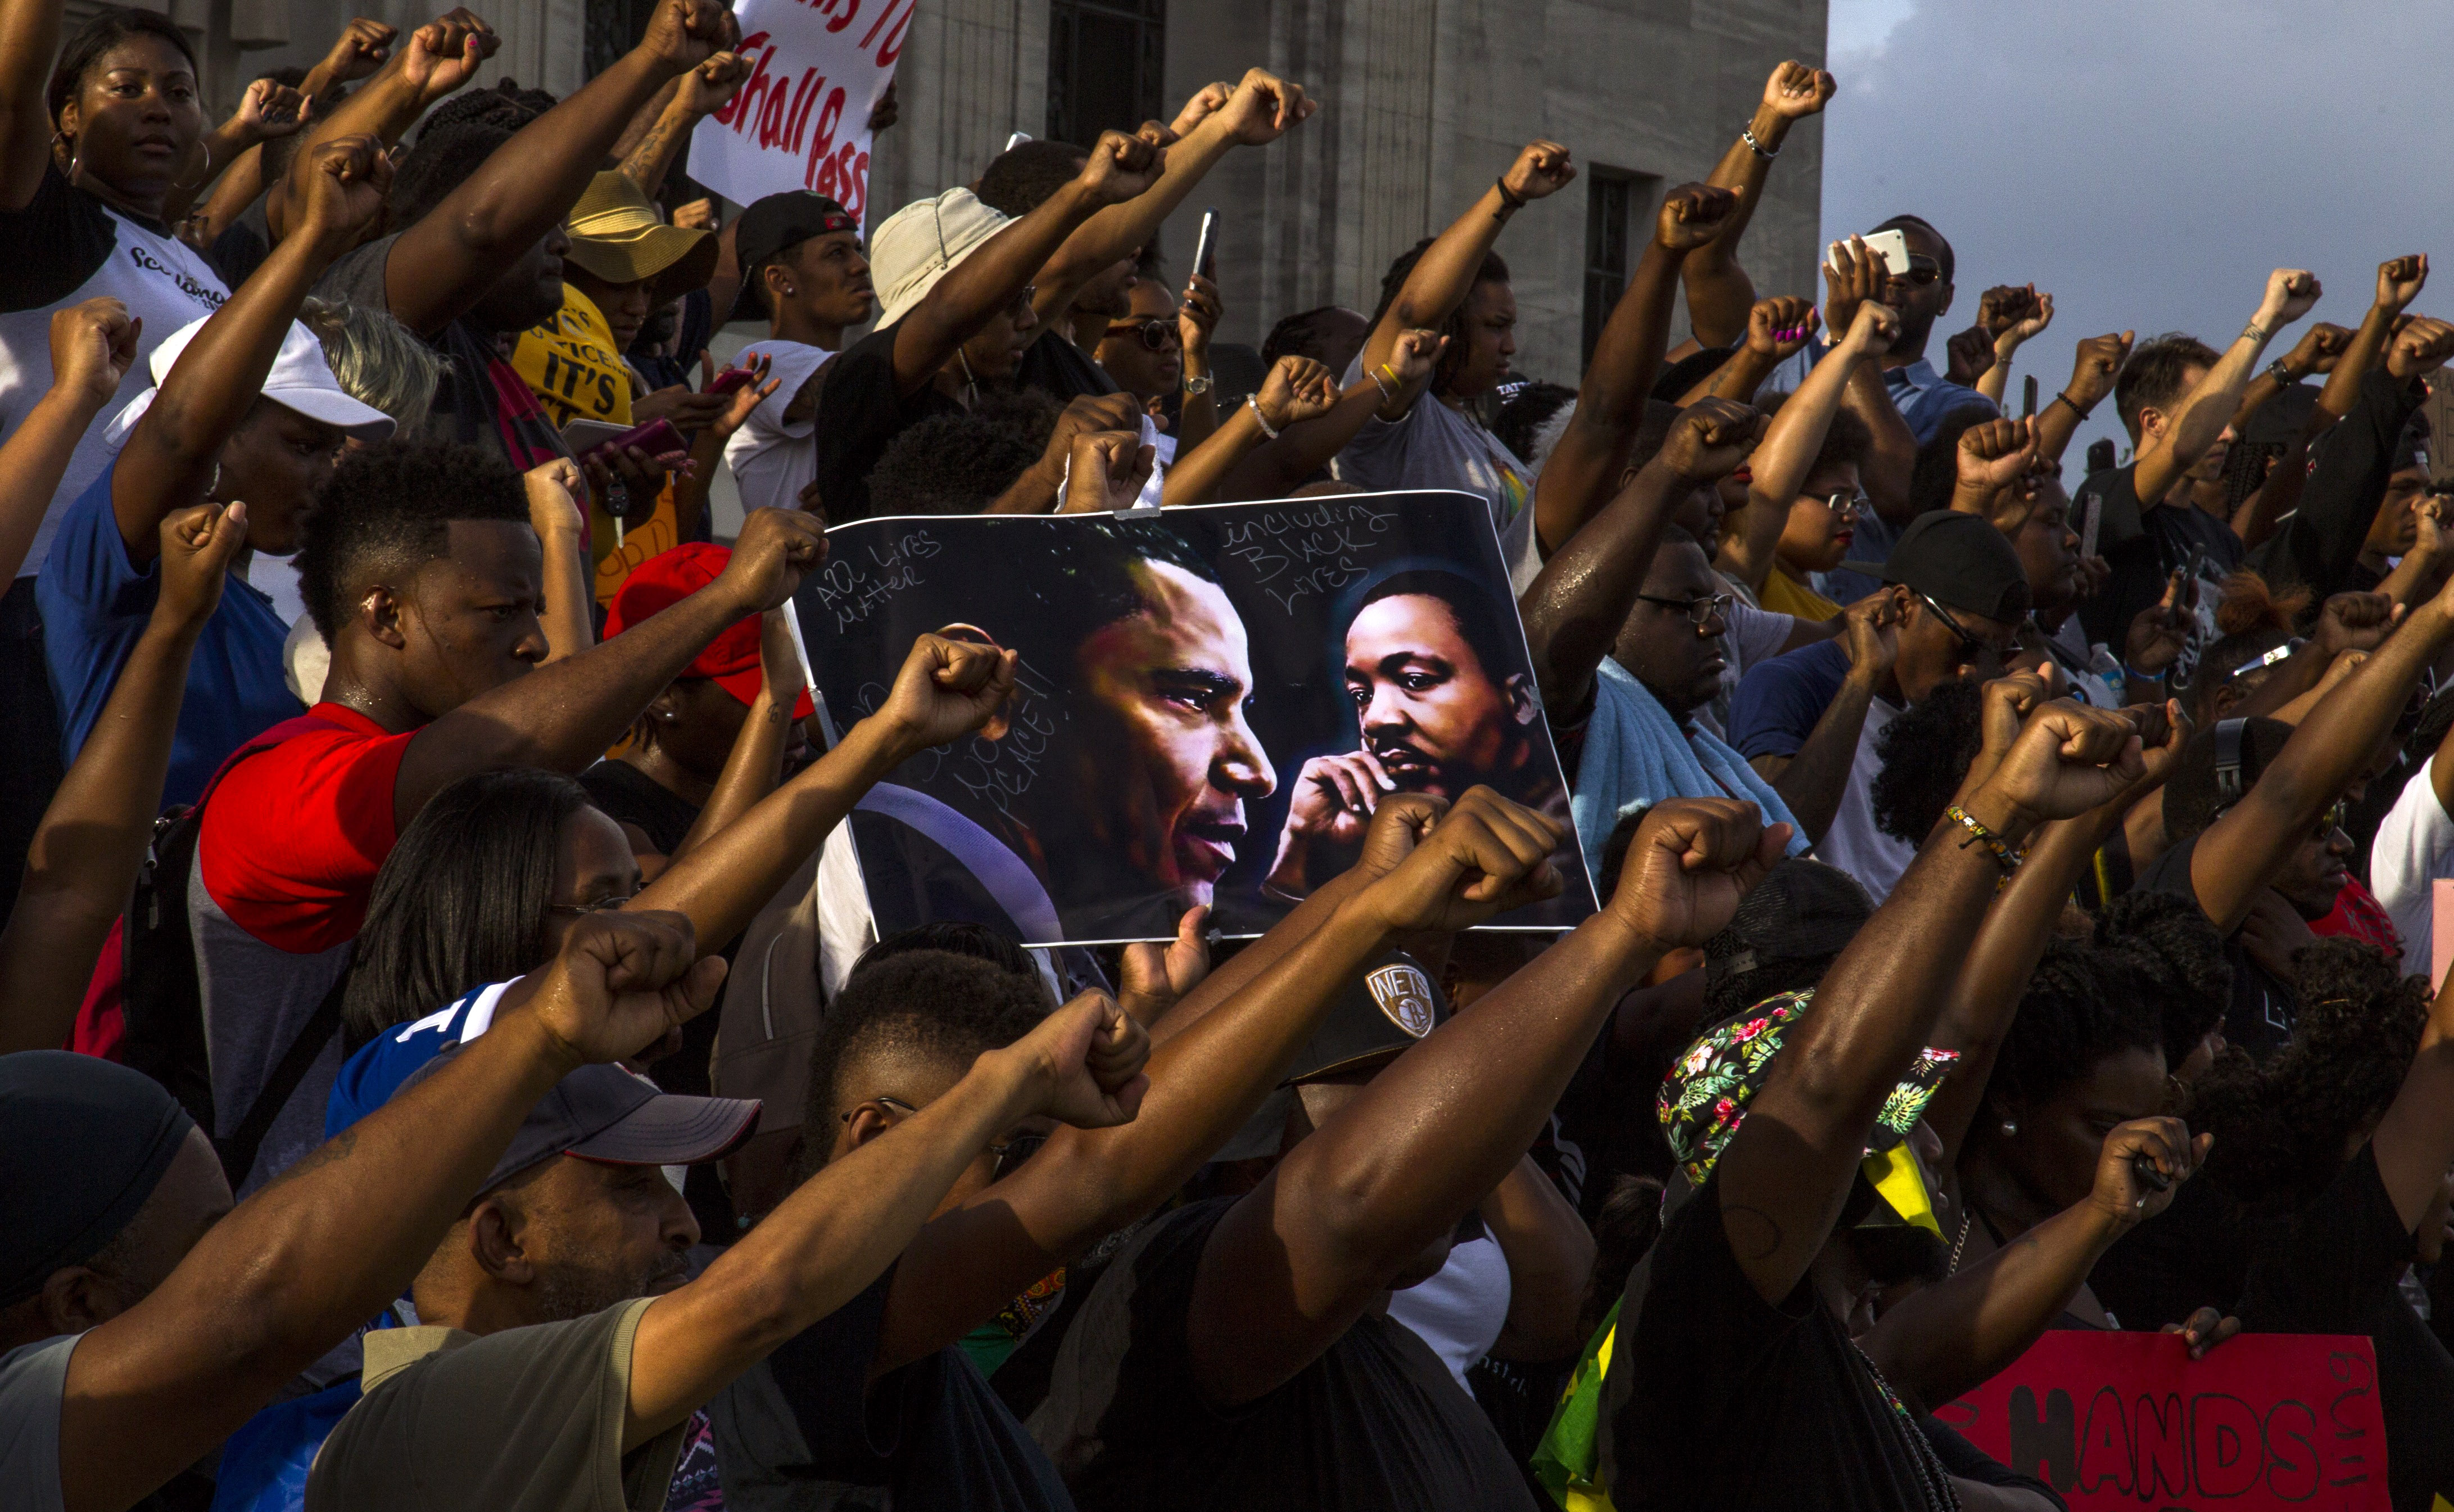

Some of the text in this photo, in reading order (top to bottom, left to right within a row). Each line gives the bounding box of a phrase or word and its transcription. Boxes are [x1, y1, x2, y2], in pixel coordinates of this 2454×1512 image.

[544, 351, 615, 415] IT'S
[1374, 968, 1431, 1002] NETS
[2008, 1384, 2321, 1502] HANDS
